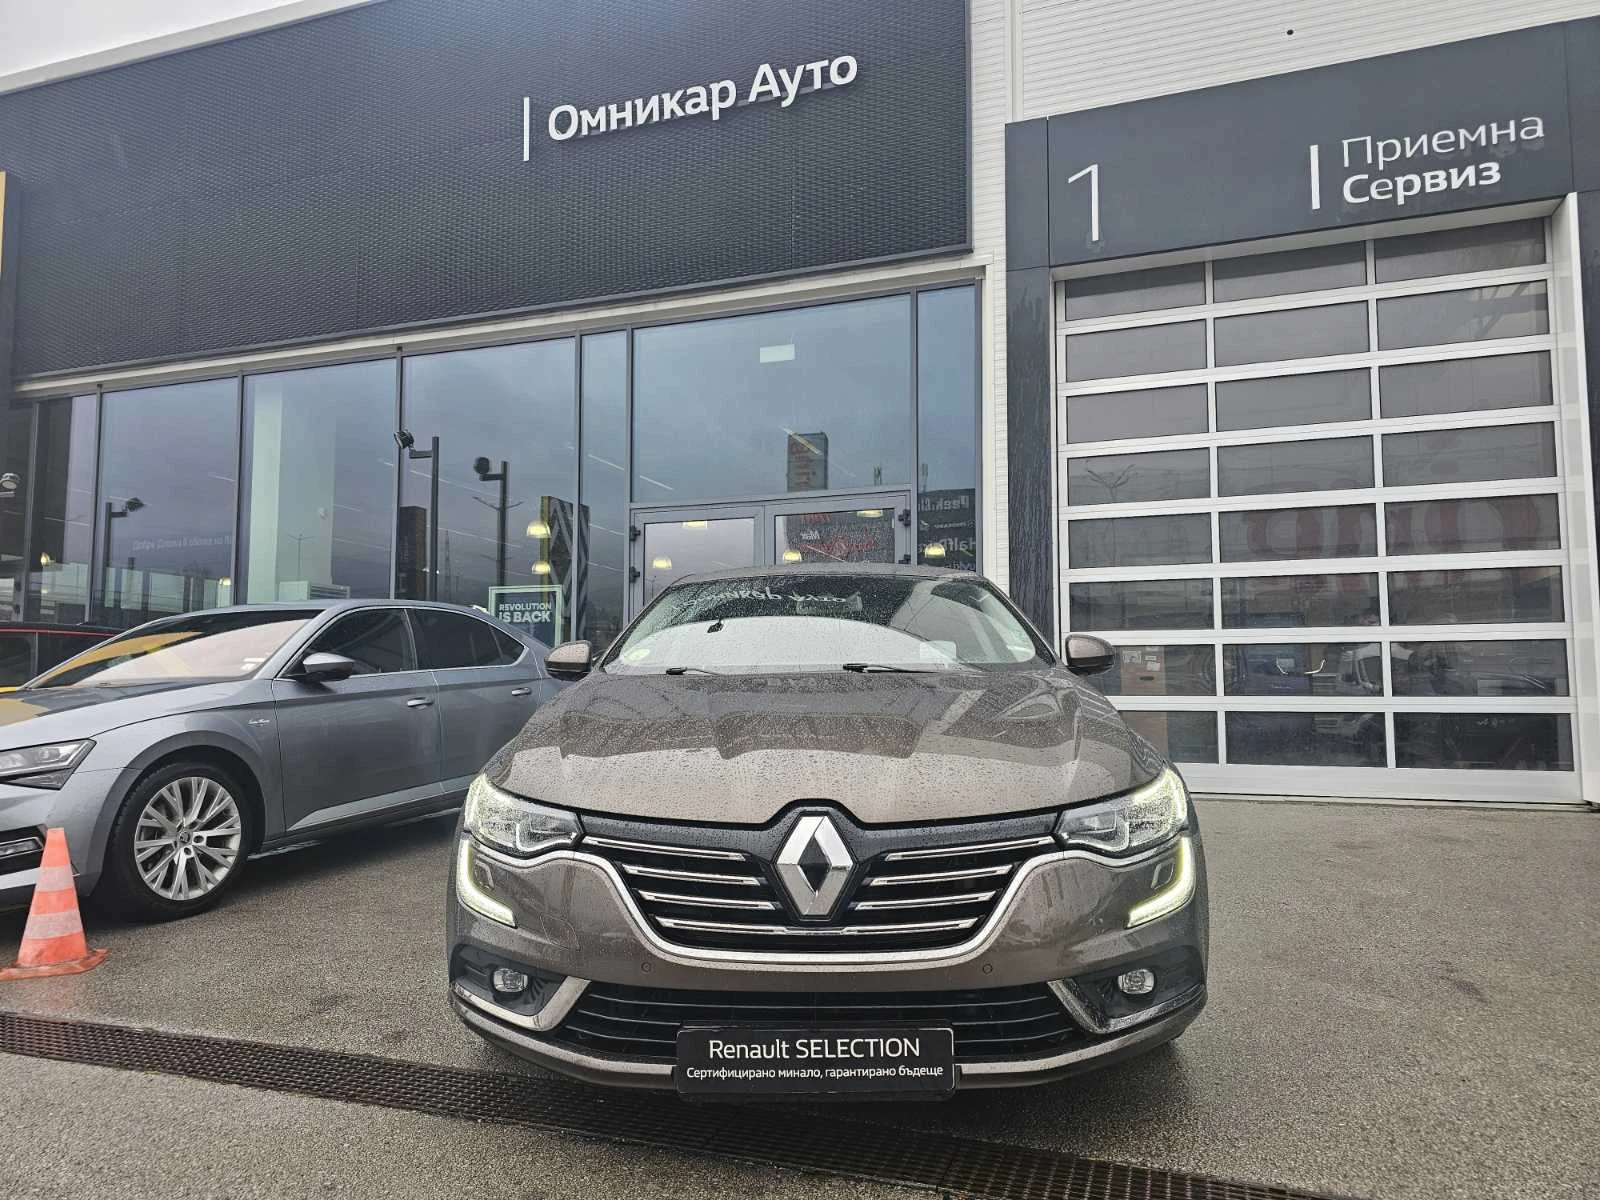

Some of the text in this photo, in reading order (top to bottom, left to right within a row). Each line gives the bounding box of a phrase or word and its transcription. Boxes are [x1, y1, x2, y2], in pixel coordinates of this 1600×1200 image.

[548, 55, 858, 141] Омникар Ауто
[1341, 116, 1545, 169] Приемна
[1342, 161, 1502, 206] Сервиз
[1067, 163, 1100, 242] 1
[499, 602, 552, 611] REVOLUTION
[499, 610, 551, 623] IS BACK
[708, 1037, 920, 1060] Renault SELECTION
[686, 1065, 944, 1081] Сертифицирано минало, гарантирано бъдеще
